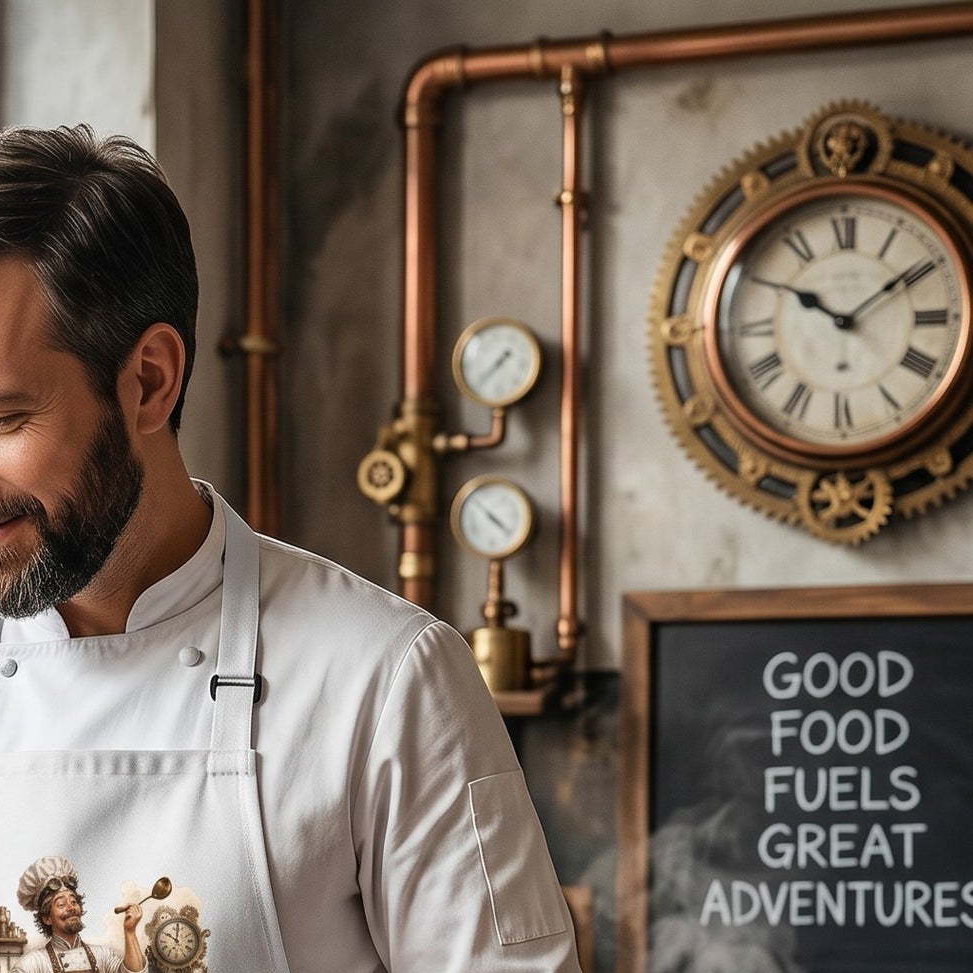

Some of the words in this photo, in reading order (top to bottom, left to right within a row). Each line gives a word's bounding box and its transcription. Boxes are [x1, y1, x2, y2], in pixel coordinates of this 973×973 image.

[762, 650, 914, 700] GOOD
[770, 708, 910, 756] FOOD
[764, 765, 921, 813] FUELS
[757, 822, 927, 870] GREAT
